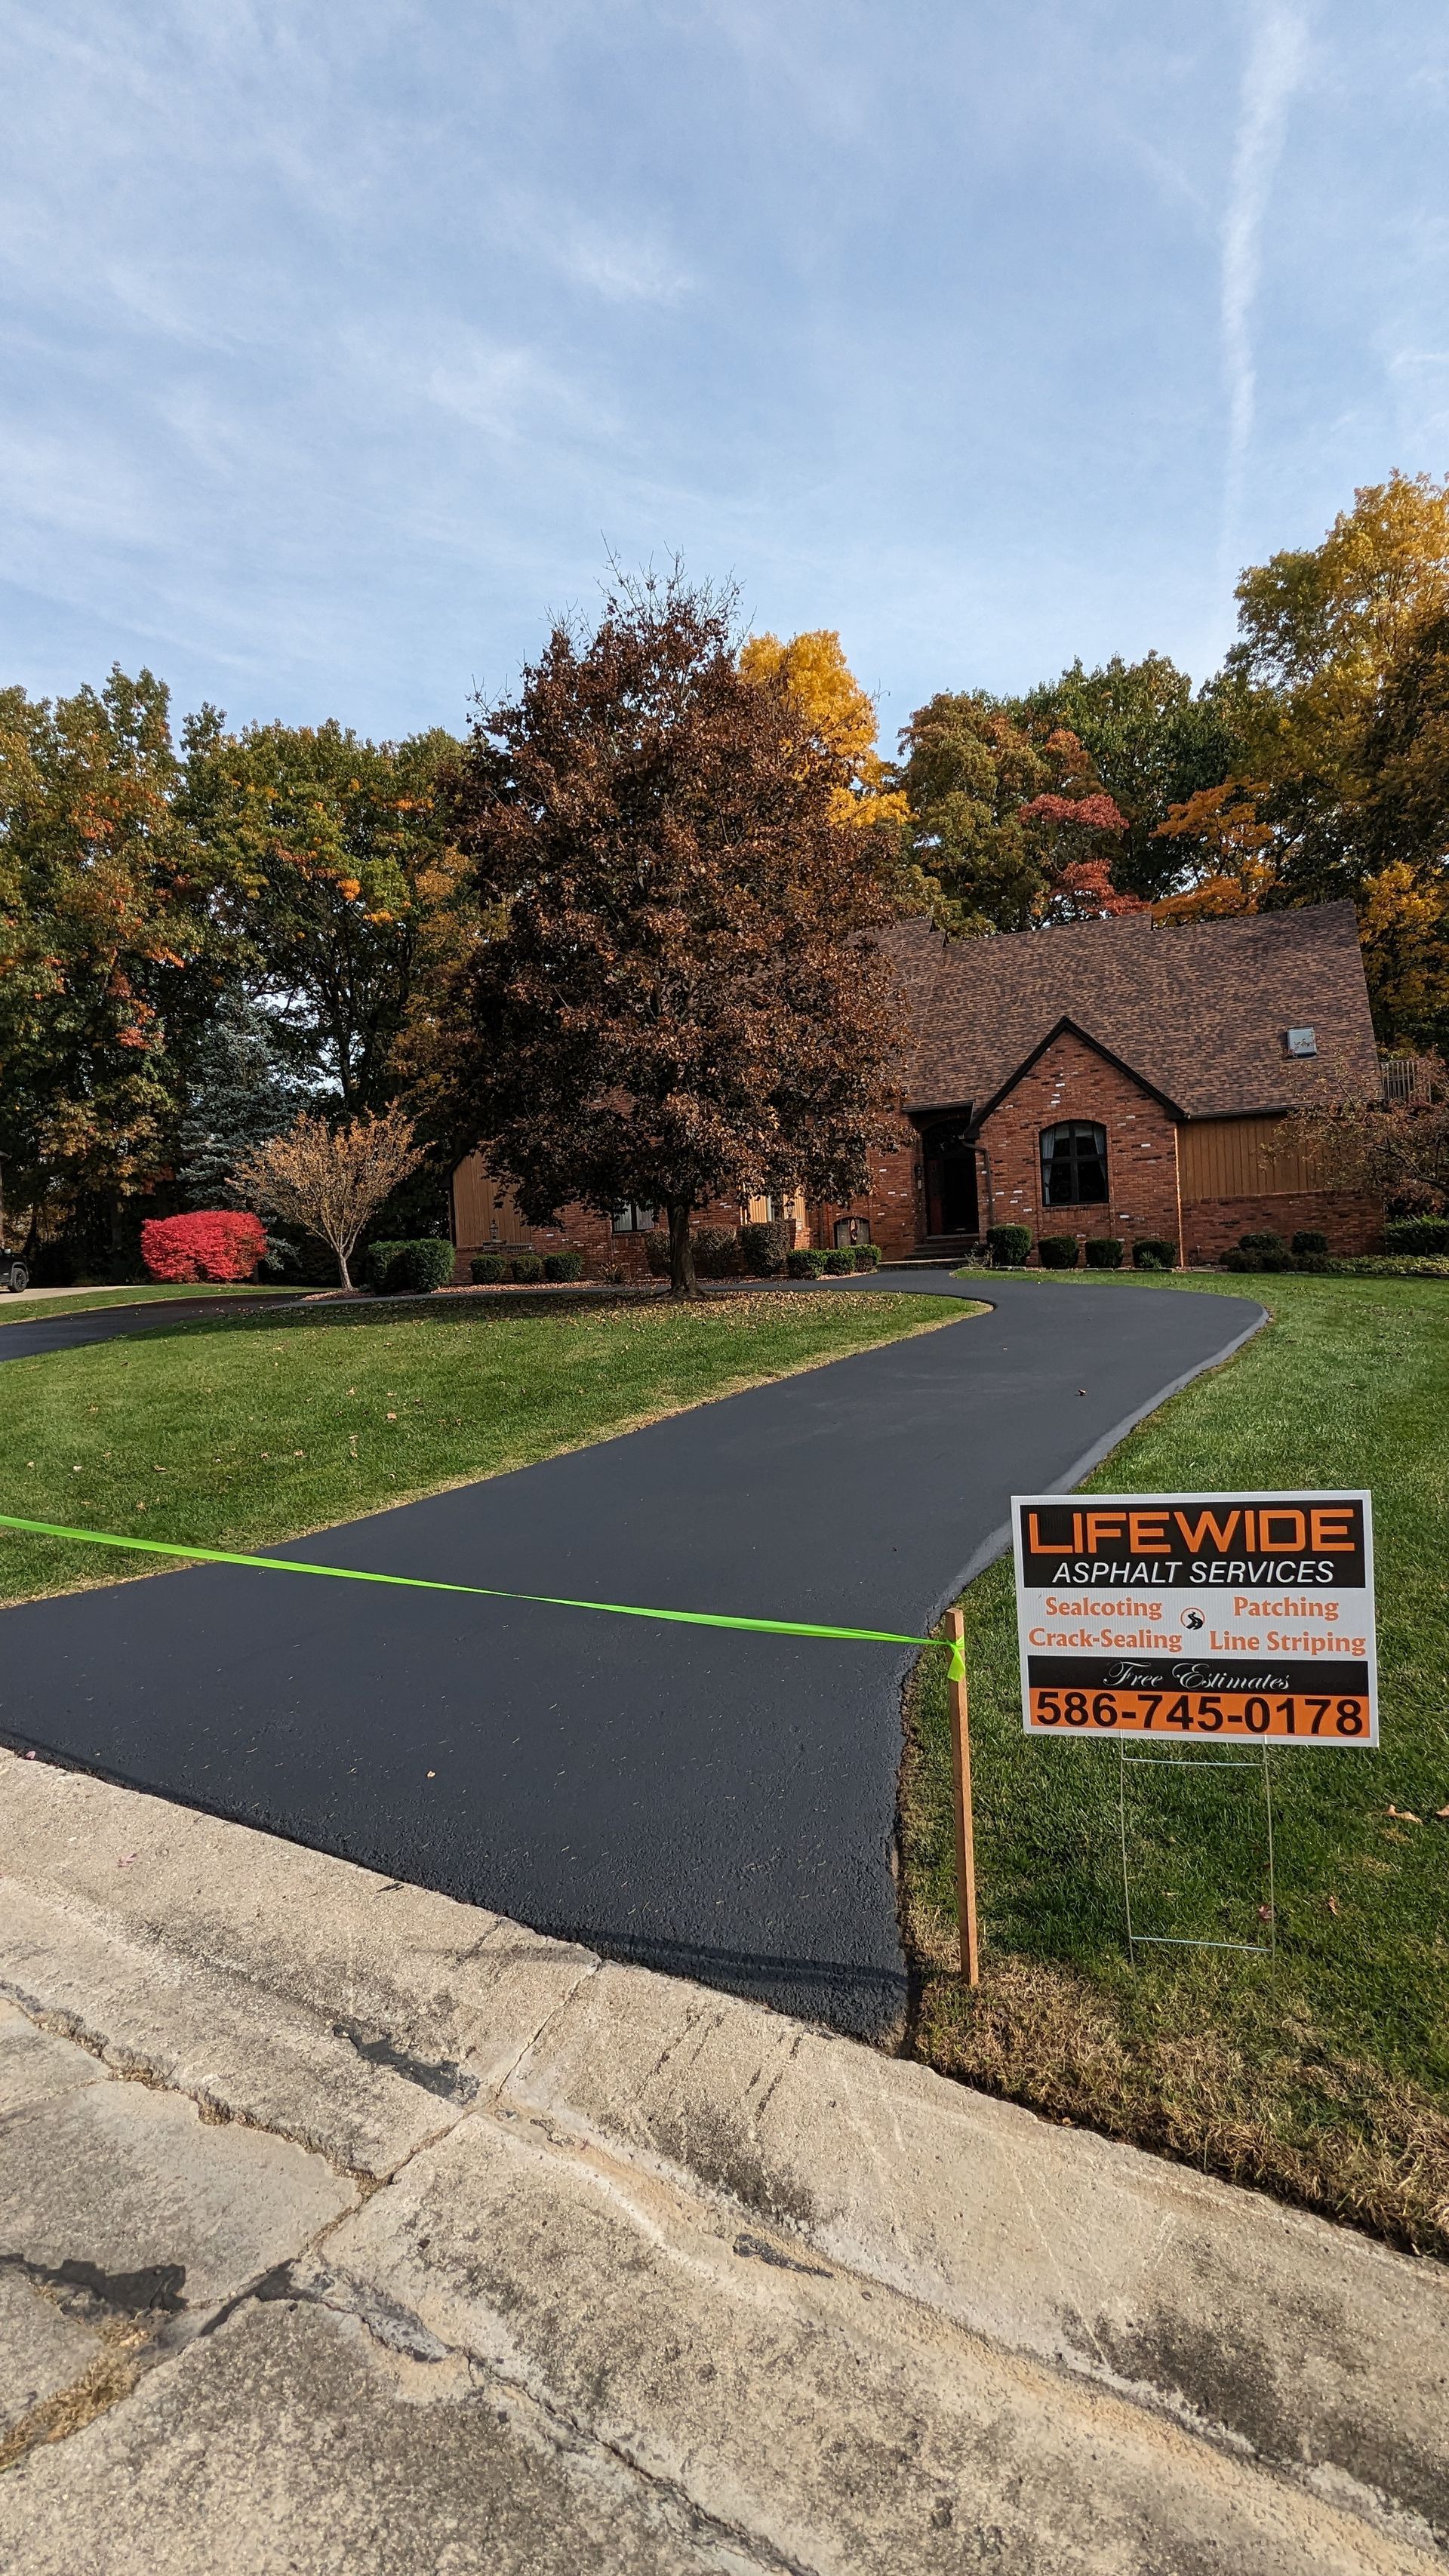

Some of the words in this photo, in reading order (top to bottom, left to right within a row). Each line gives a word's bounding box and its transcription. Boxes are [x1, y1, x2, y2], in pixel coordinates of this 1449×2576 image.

[1029, 1509, 1355, 1553] LIFEWIDE
[1053, 1562, 1182, 1583] ASPHALT
[1189, 1561, 1334, 1583] SERVICES
[1046, 1597, 1162, 1620] Sealcoting
[1234, 1596, 1339, 1620] Patching
[1029, 1628, 1182, 1652] Crack-Sealing
[1210, 1631, 1260, 1650] Line
[1267, 1631, 1366, 1656] Striping
[1103, 1661, 1163, 1685] Free
[1172, 1663, 1288, 1690] Estimates
[1037, 1691, 1362, 1734] 586-745-0178
